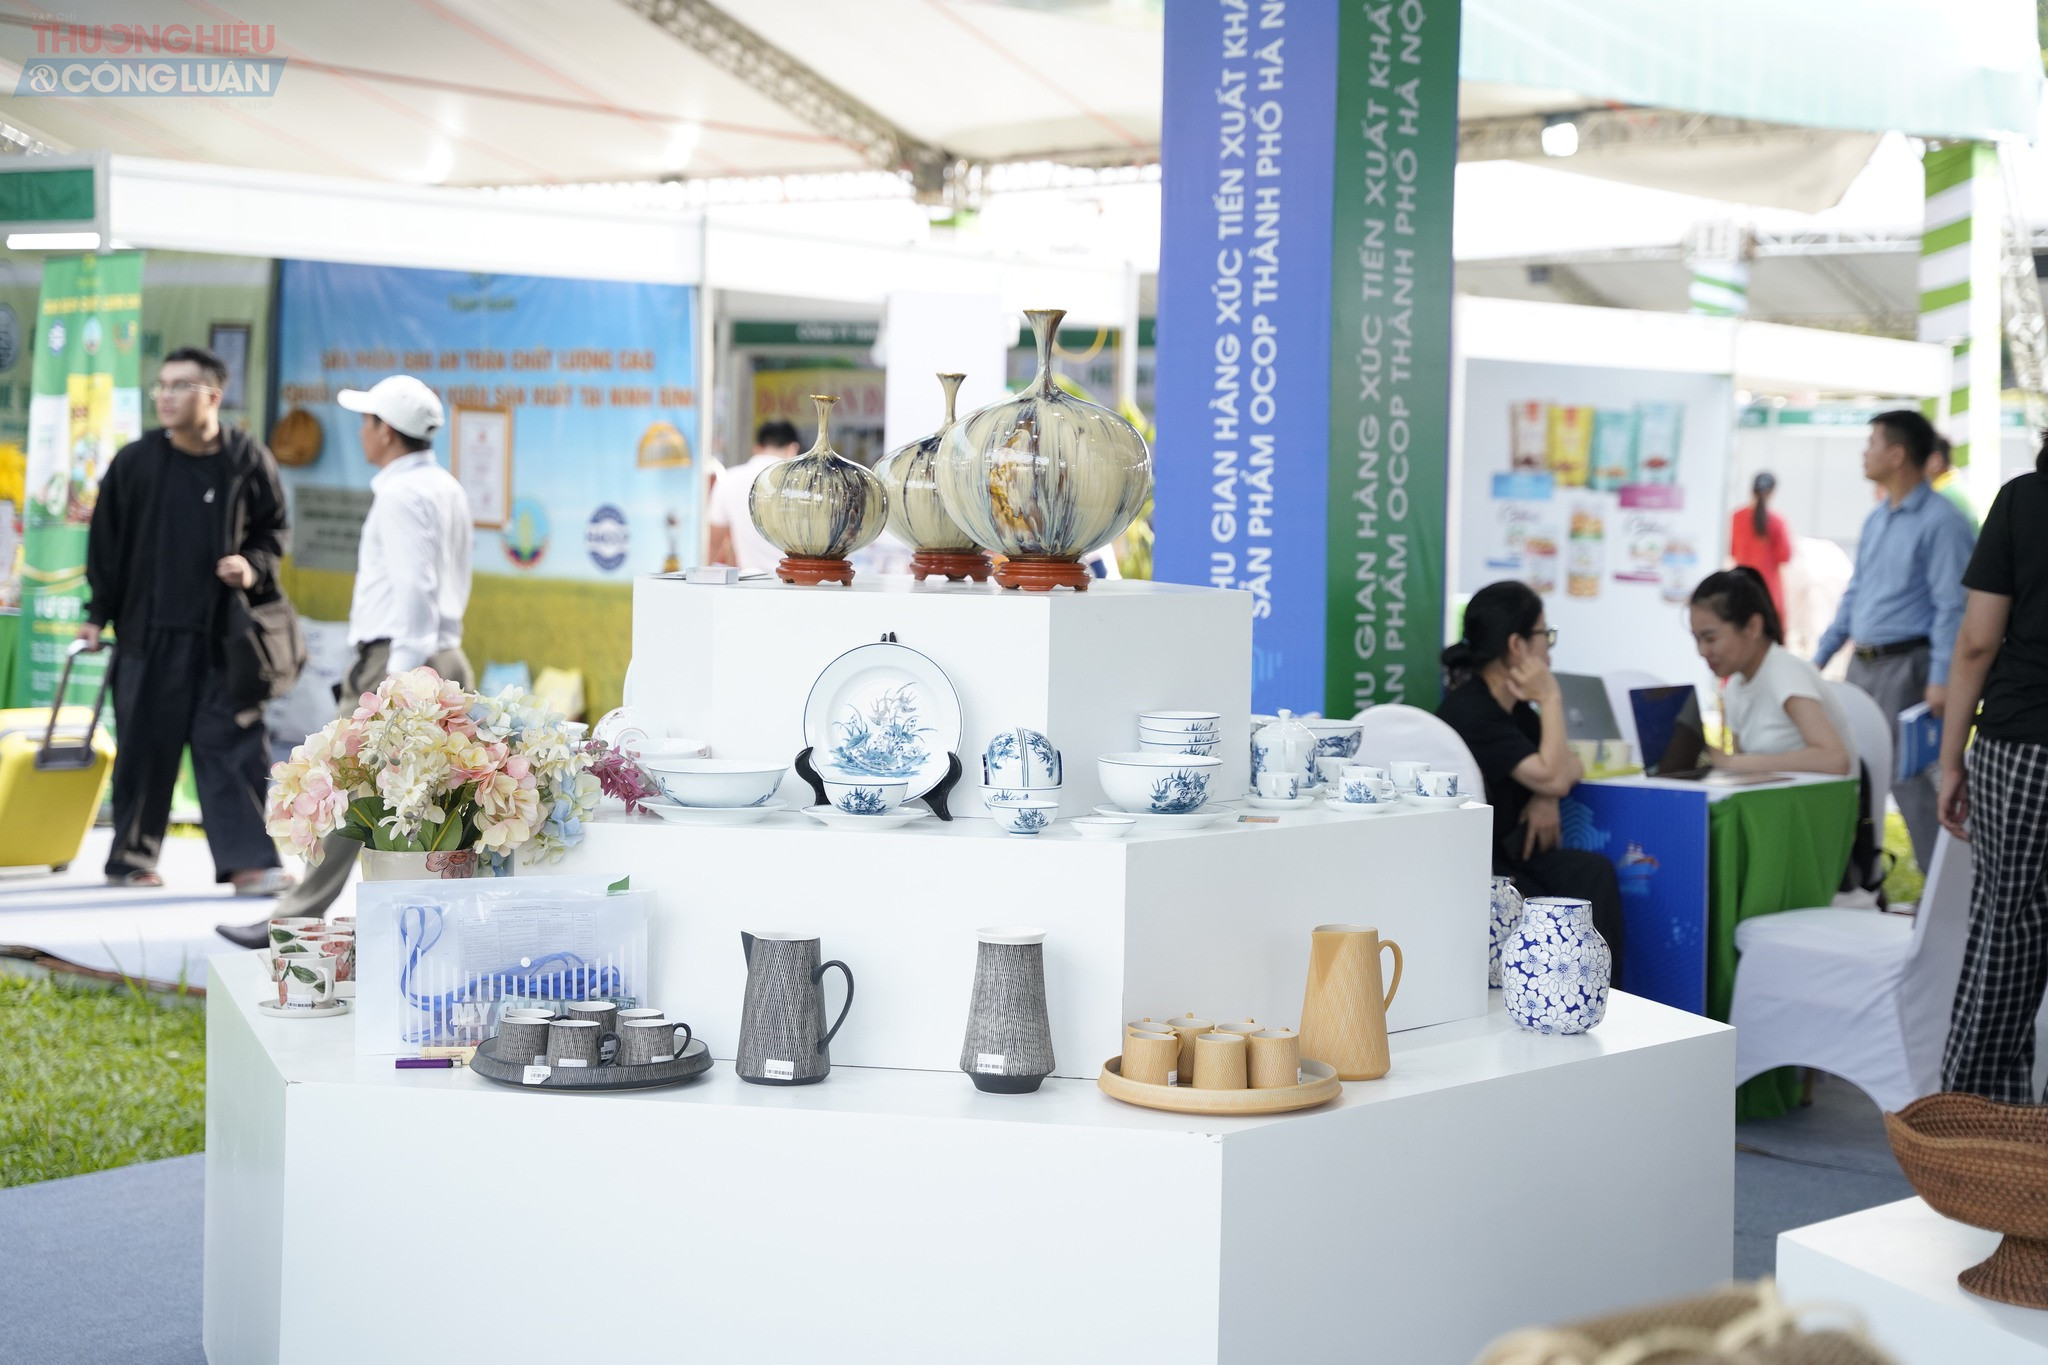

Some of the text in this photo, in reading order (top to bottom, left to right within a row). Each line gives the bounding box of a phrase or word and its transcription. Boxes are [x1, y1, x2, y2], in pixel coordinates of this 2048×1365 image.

[1253, 37, 1285, 91] HÀ
[1363, 0, 1393, 89] KHẨ
[1397, 0, 1427, 65] NỘ
[1215, 69, 1247, 159] XUẤT
[1250, 101, 1283, 176] PHỐ
[1394, 78, 1420, 135] HÀ
[1361, 98, 1389, 207] XUẤT
[1392, 147, 1419, 235] PHỐ
[1212, 168, 1245, 240] TIẾN
[1249, 187, 1281, 306] THÀNH
[1211, 248, 1243, 325] XÚC
[1357, 218, 1386, 300] TIẾN
[1355, 314, 1384, 402] XÚC
[1388, 247, 1415, 381] THÀNH
[1209, 333, 1241, 440] HÀNG
[1249, 314, 1278, 425] OCOP
[1210, 451, 1238, 543] GIAN
[1240, 434, 1275, 537] PHẨM
[1353, 414, 1381, 538] HÀNG
[1386, 394, 1411, 522] OCOP
[1238, 547, 1272, 619] SẢN
[1354, 552, 1378, 659] GIAN
[1380, 534, 1408, 651] PHẨM
